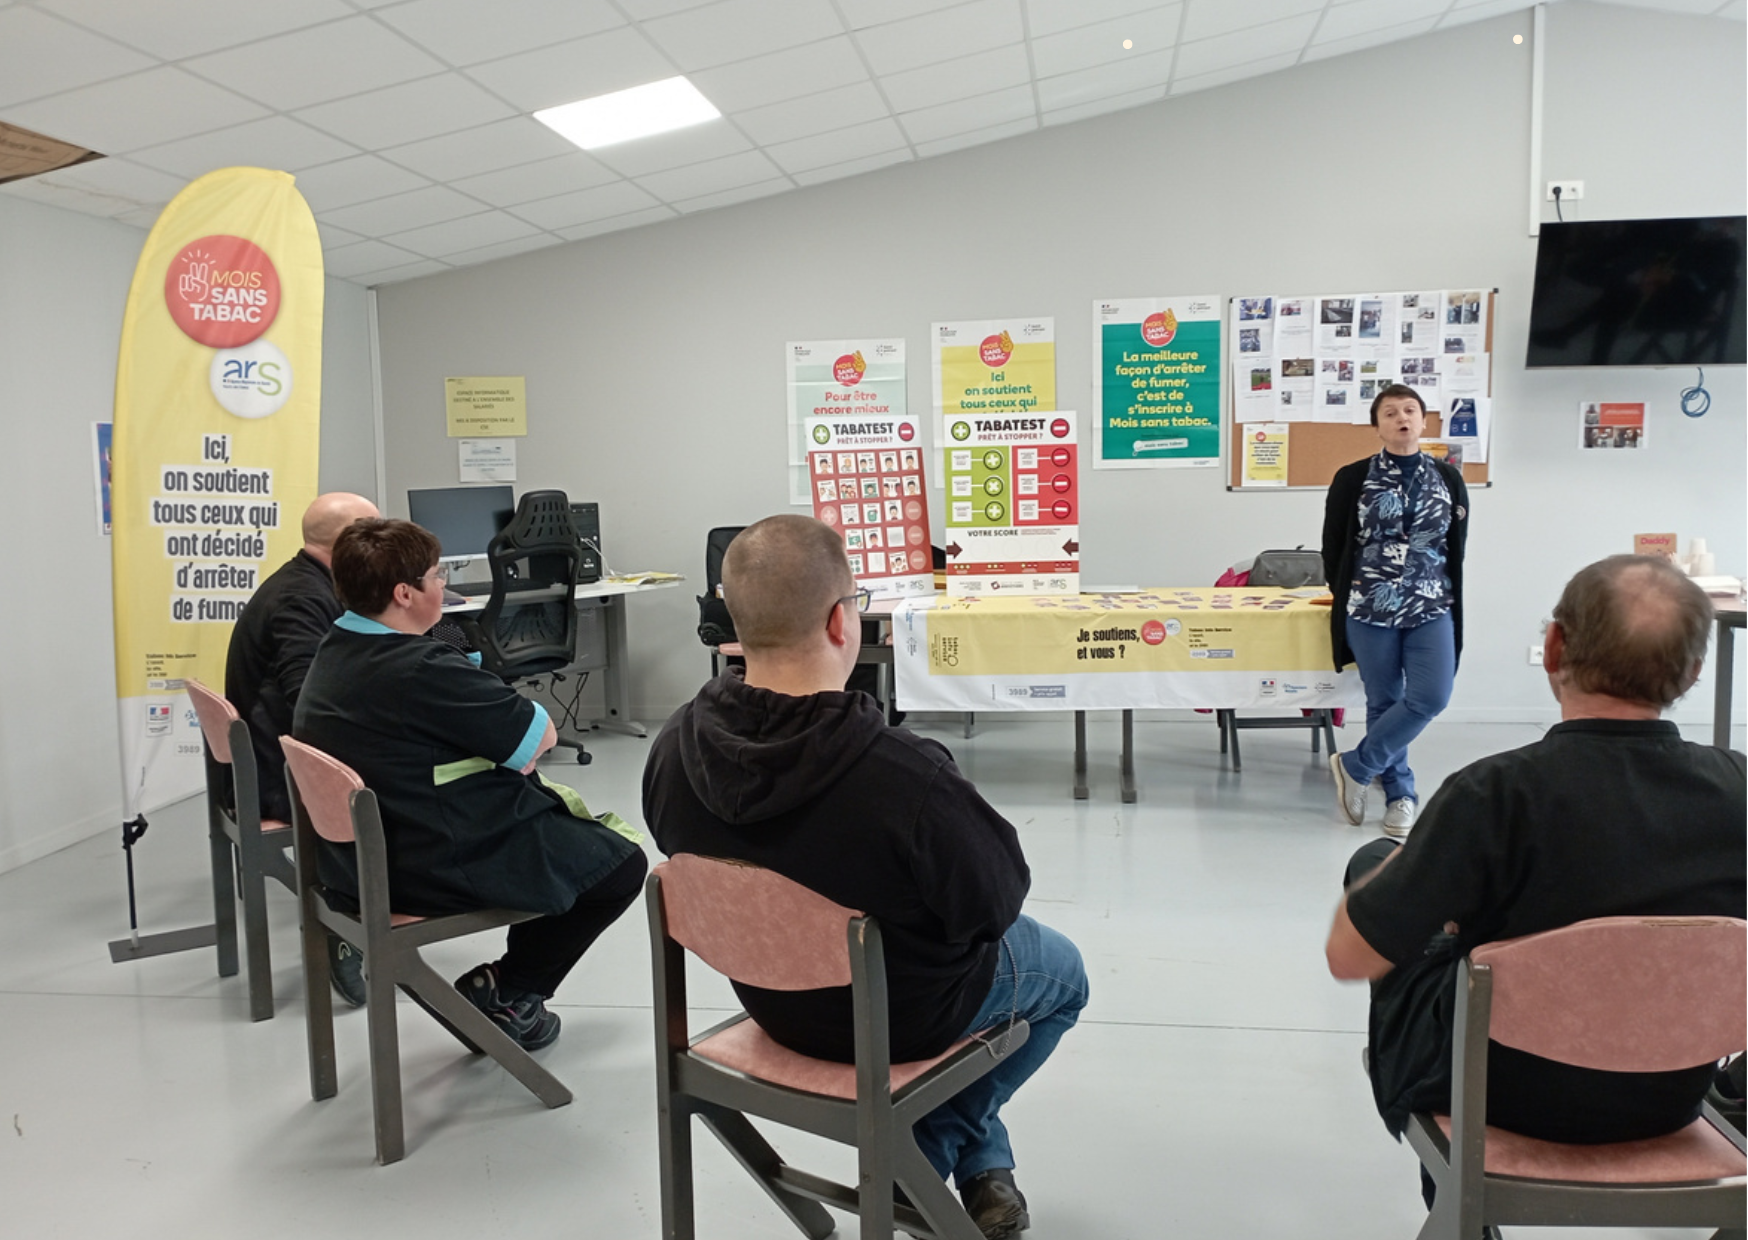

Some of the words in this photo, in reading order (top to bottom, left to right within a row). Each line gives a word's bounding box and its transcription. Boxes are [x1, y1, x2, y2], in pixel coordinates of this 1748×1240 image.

[211, 270, 262, 288] MOIS
[211, 288, 268, 306] SANS
[190, 303, 262, 323] TABAC
[1123, 352, 1138, 362] La
[1141, 351, 1198, 361] meilleure
[991, 372, 1005, 382] Ici
[1115, 365, 1150, 377] façon
[1132, 378, 1147, 388] de
[1149, 376, 1190, 388] fumer,
[982, 384, 1032, 395] soutient
[1168, 390, 1184, 400] de
[825, 392, 851, 402] Pour
[854, 390, 877, 401] être
[960, 400, 986, 409] tous
[988, 400, 1016, 408] ceux
[1019, 396, 1037, 409] qui
[1185, 402, 1193, 412] à
[814, 406, 852, 414] encore
[854, 404, 889, 414] mieux
[975, 418, 1046, 432] TABATEST
[1110, 418, 1138, 428] Mois
[1140, 418, 1170, 427] sans
[1172, 416, 1212, 426] tabac.
[833, 422, 894, 435] TABATEST
[837, 436, 853, 444] PRÊT
[854, 435, 859, 443] À
[861, 436, 888, 444] STOPPER
[978, 433, 996, 441] PRÊT
[204, 436, 229, 464] Ici,
[164, 471, 188, 491] on
[193, 469, 269, 494] soutient
[154, 501, 196, 524] tous
[201, 505, 245, 525] ceux
[249, 503, 277, 529] qui
[168, 534, 198, 556] ont
[202, 529, 264, 557] décidé
[1641, 536, 1670, 545] Daddy
[173, 598, 193, 620] de
[198, 599, 246, 620] fume
[1077, 628, 1089, 642] Je
[1093, 627, 1140, 642] soutiens,
[1077, 647, 1087, 660] et
[1090, 647, 1115, 659] vous
[1119, 645, 1125, 658] ?
[178, 745, 200, 754] 3989
